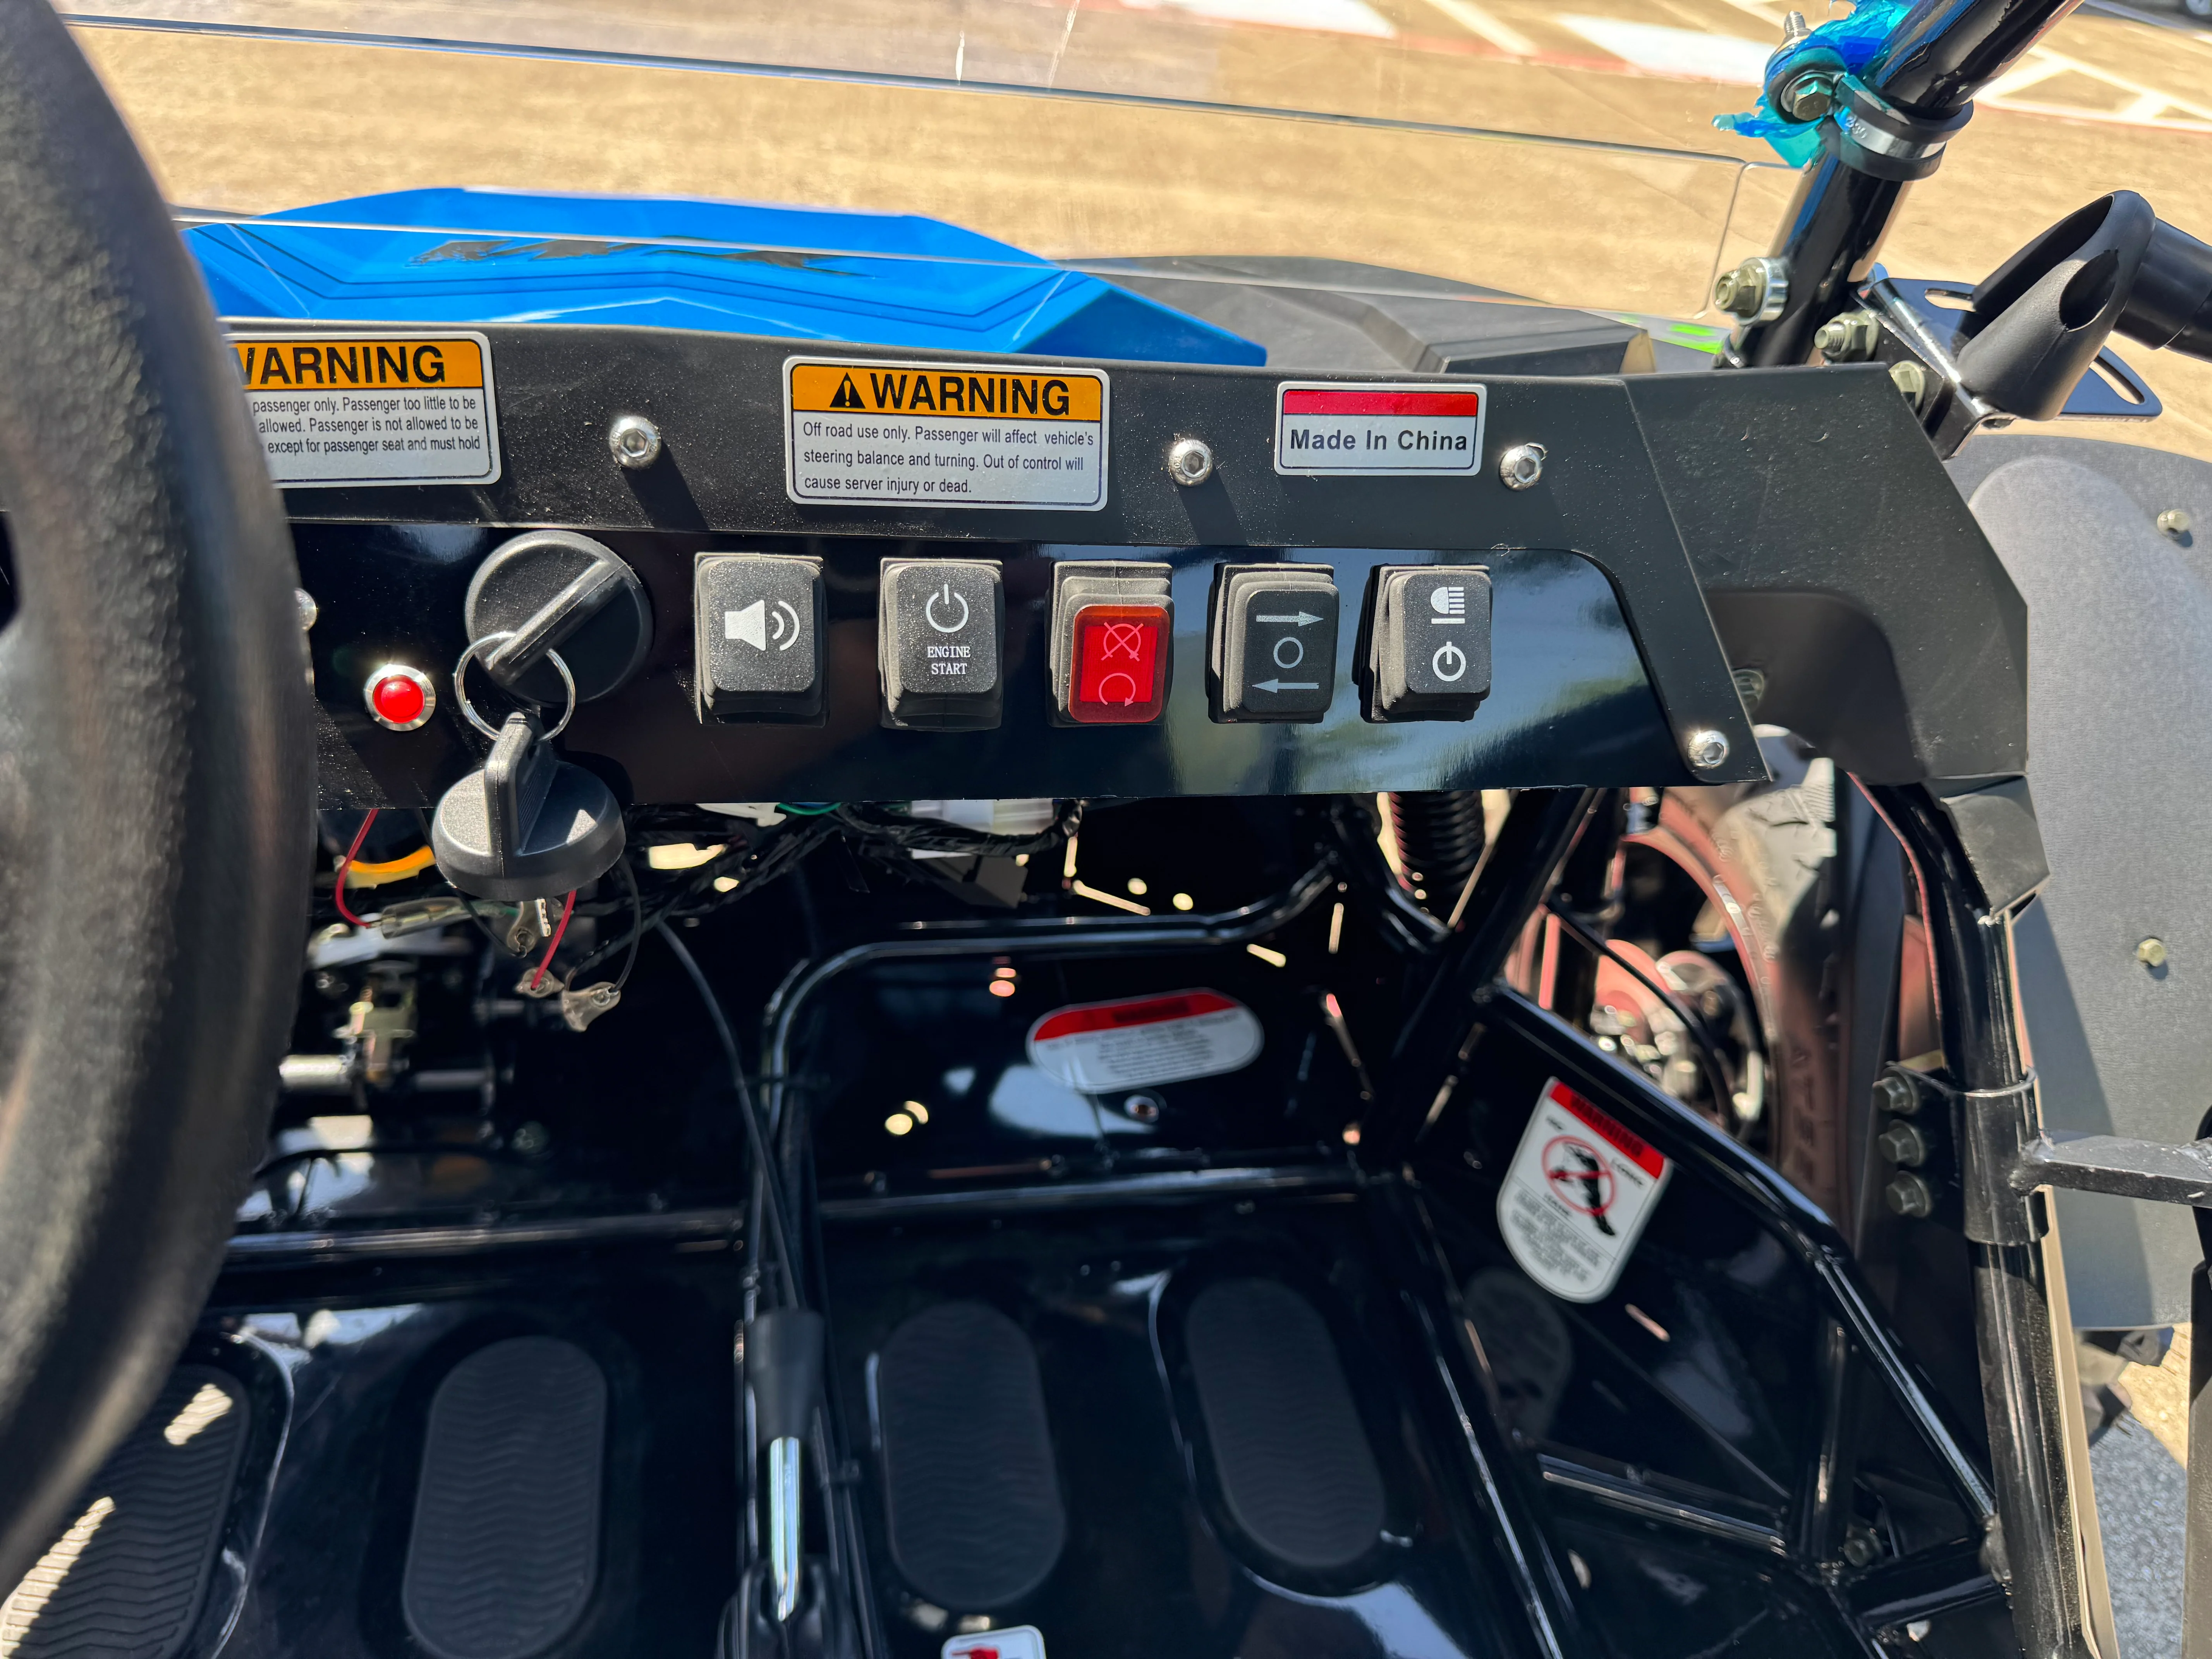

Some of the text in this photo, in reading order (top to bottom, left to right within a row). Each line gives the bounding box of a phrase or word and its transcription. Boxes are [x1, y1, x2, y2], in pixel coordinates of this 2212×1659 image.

[870, 373, 1069, 416] WARNING
[252, 396, 476, 416] passenger only. Passenger too little to be
[259, 416, 478, 434] allowed. Passenger is not allowed to be
[804, 422, 1093, 446] Off road use only. Passenger will affect vehicle's
[268, 440, 303, 456] except
[306, 438, 320, 452] for
[324, 439, 379, 455] passenger
[382, 438, 404, 451] seat
[407, 436, 427, 450] and
[430, 437, 455, 450] must
[459, 434, 480, 449] hold
[1290, 429, 1467, 450] Made In China
[804, 449, 1083, 471] steering balance and turning. Out of control will
[805, 478, 972, 495] cause server injury or dead.
[927, 646, 971, 658] ENGINE
[931, 663, 968, 675] START
